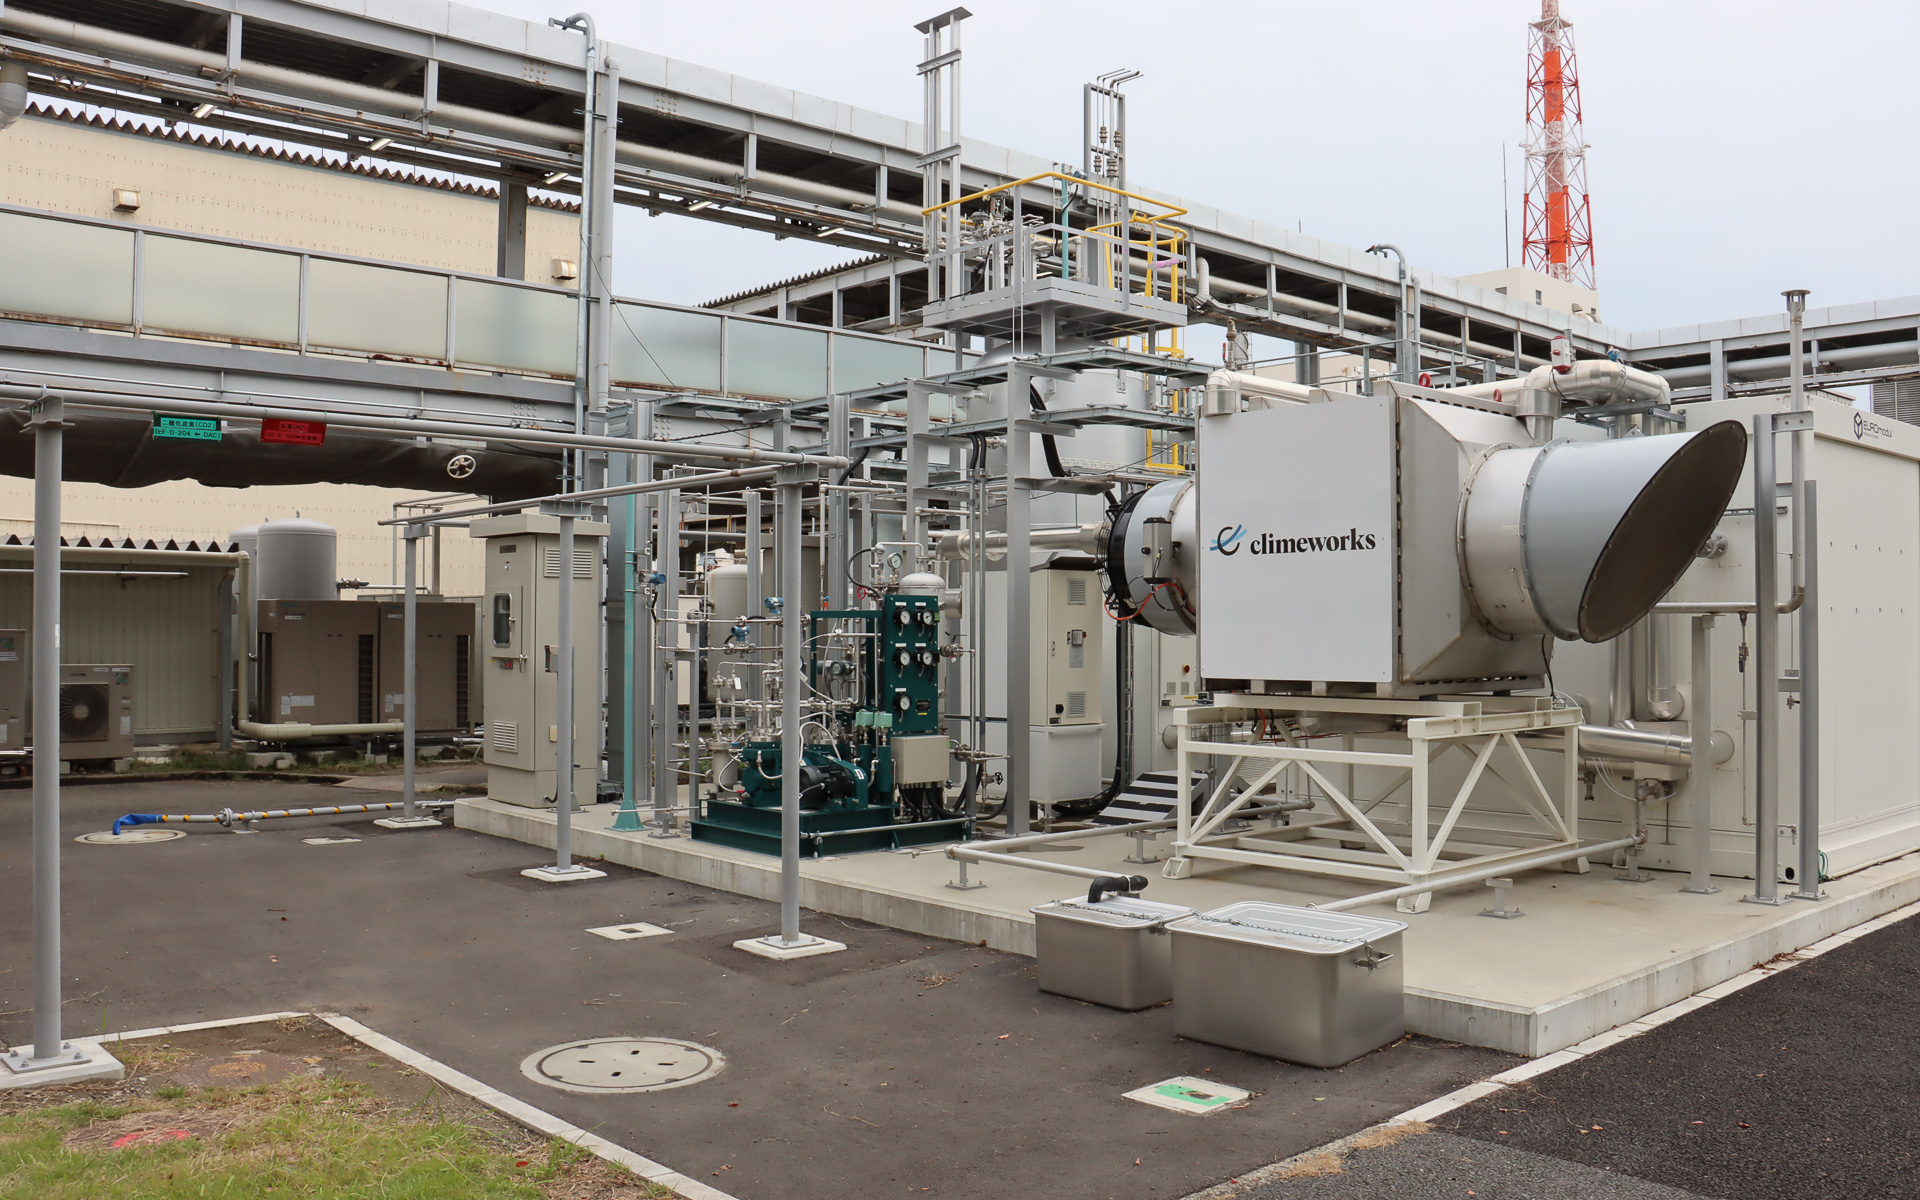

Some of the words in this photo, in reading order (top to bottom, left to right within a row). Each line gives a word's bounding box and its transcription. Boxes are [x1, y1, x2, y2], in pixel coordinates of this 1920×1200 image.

[161, 418, 216, 429] 二酸化炭素(CO2)
[1250, 528, 1376, 555] climeworks
